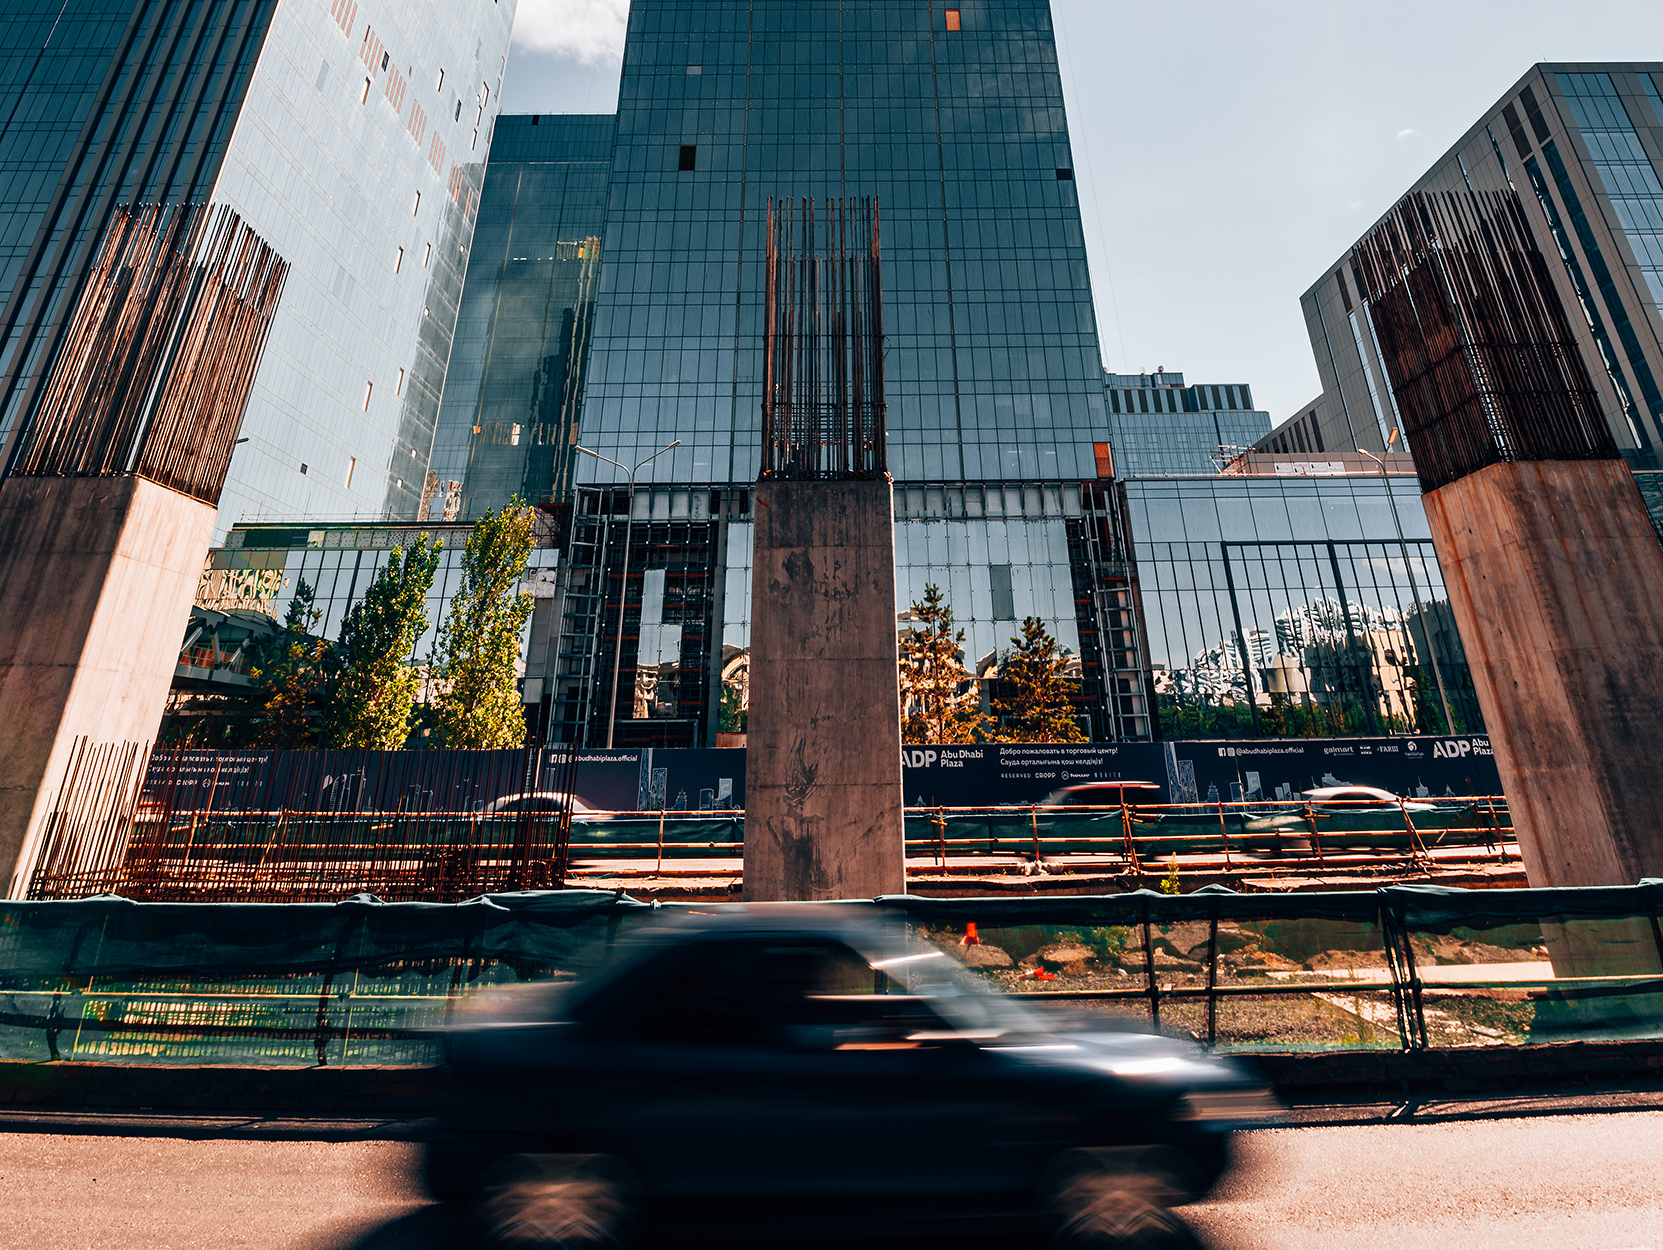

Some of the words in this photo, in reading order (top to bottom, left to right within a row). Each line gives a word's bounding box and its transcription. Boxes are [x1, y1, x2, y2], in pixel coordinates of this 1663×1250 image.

[1472, 737, 1490, 747] Abu
[999, 747, 1021, 756] Добро
[1066, 747, 1096, 756] торговый
[1097, 747, 1118, 756] центр!
[1236, 747, 1304, 756] @abudhabiplaza.official
[1324, 746, 1354, 755] galmart
[1433, 739, 1471, 759] ADP
[941, 750, 959, 759] Abu
[959, 749, 984, 759] Dhabi
[941, 758, 964, 768] Plaza
[1000, 758, 1020, 767] Сауда
